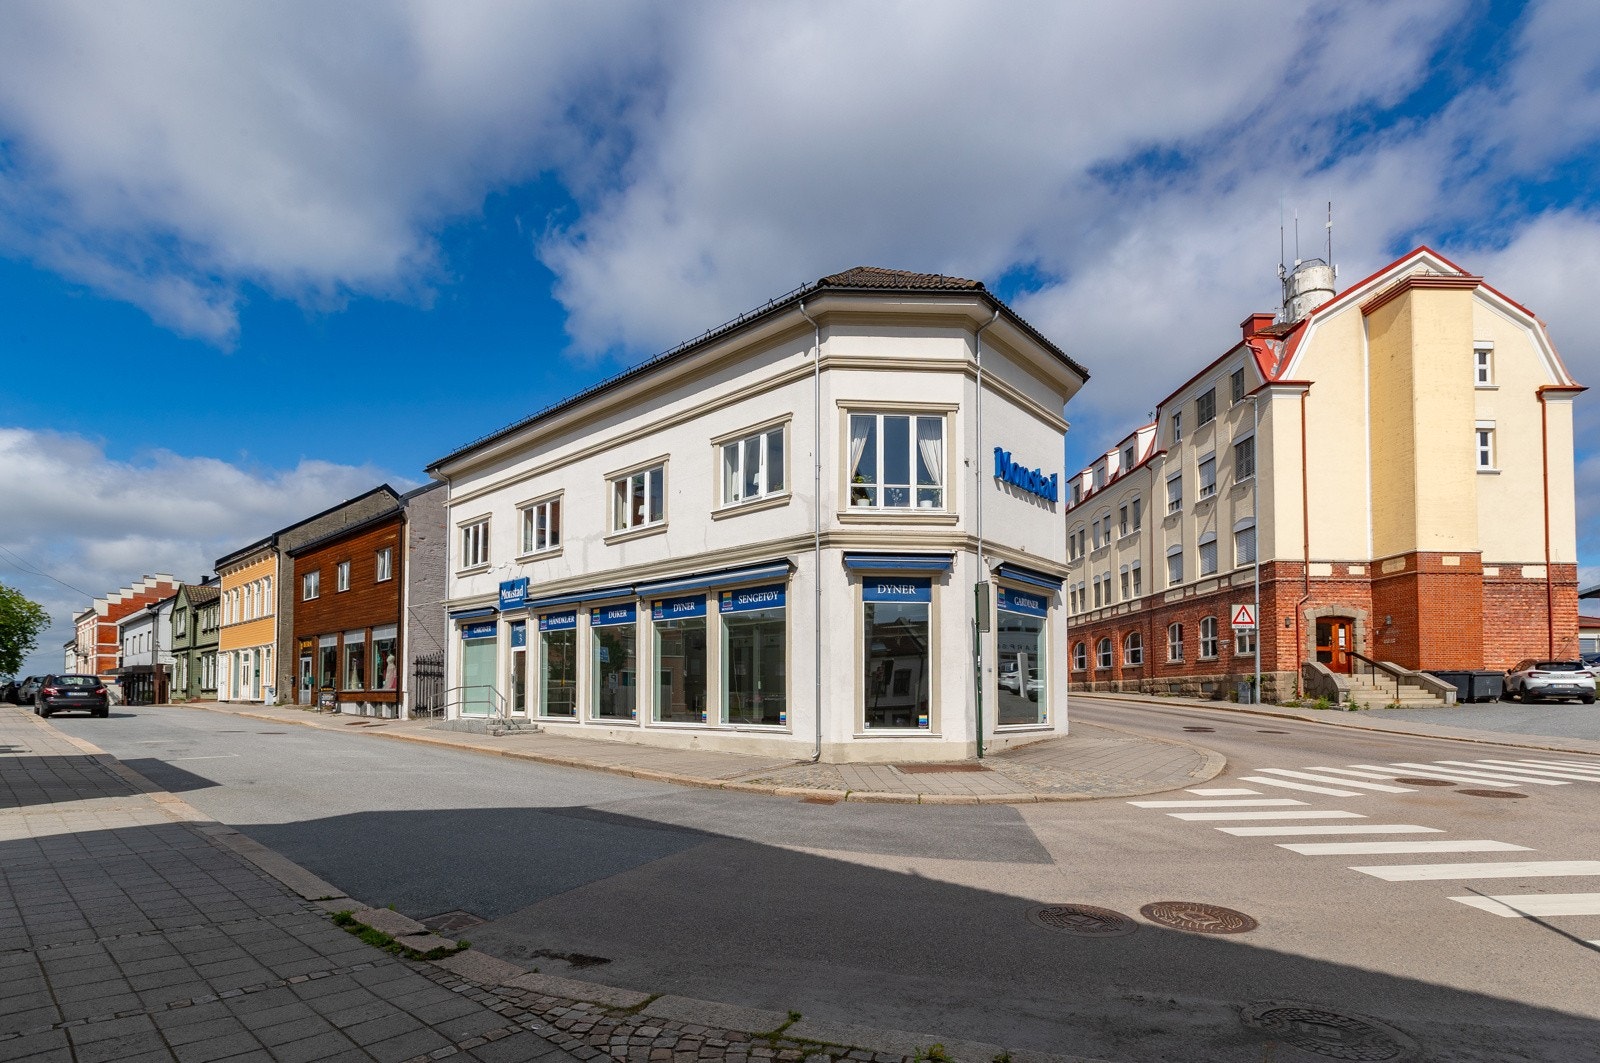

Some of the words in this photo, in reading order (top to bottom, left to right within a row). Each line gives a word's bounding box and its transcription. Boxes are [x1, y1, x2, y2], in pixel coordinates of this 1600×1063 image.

[877, 584, 917, 595] DYNER
[738, 591, 779, 605] SENGETØY
[1013, 596, 1039, 609] GARDINER
[673, 602, 696, 612] DYNER
[608, 610, 628, 619] DUKER
